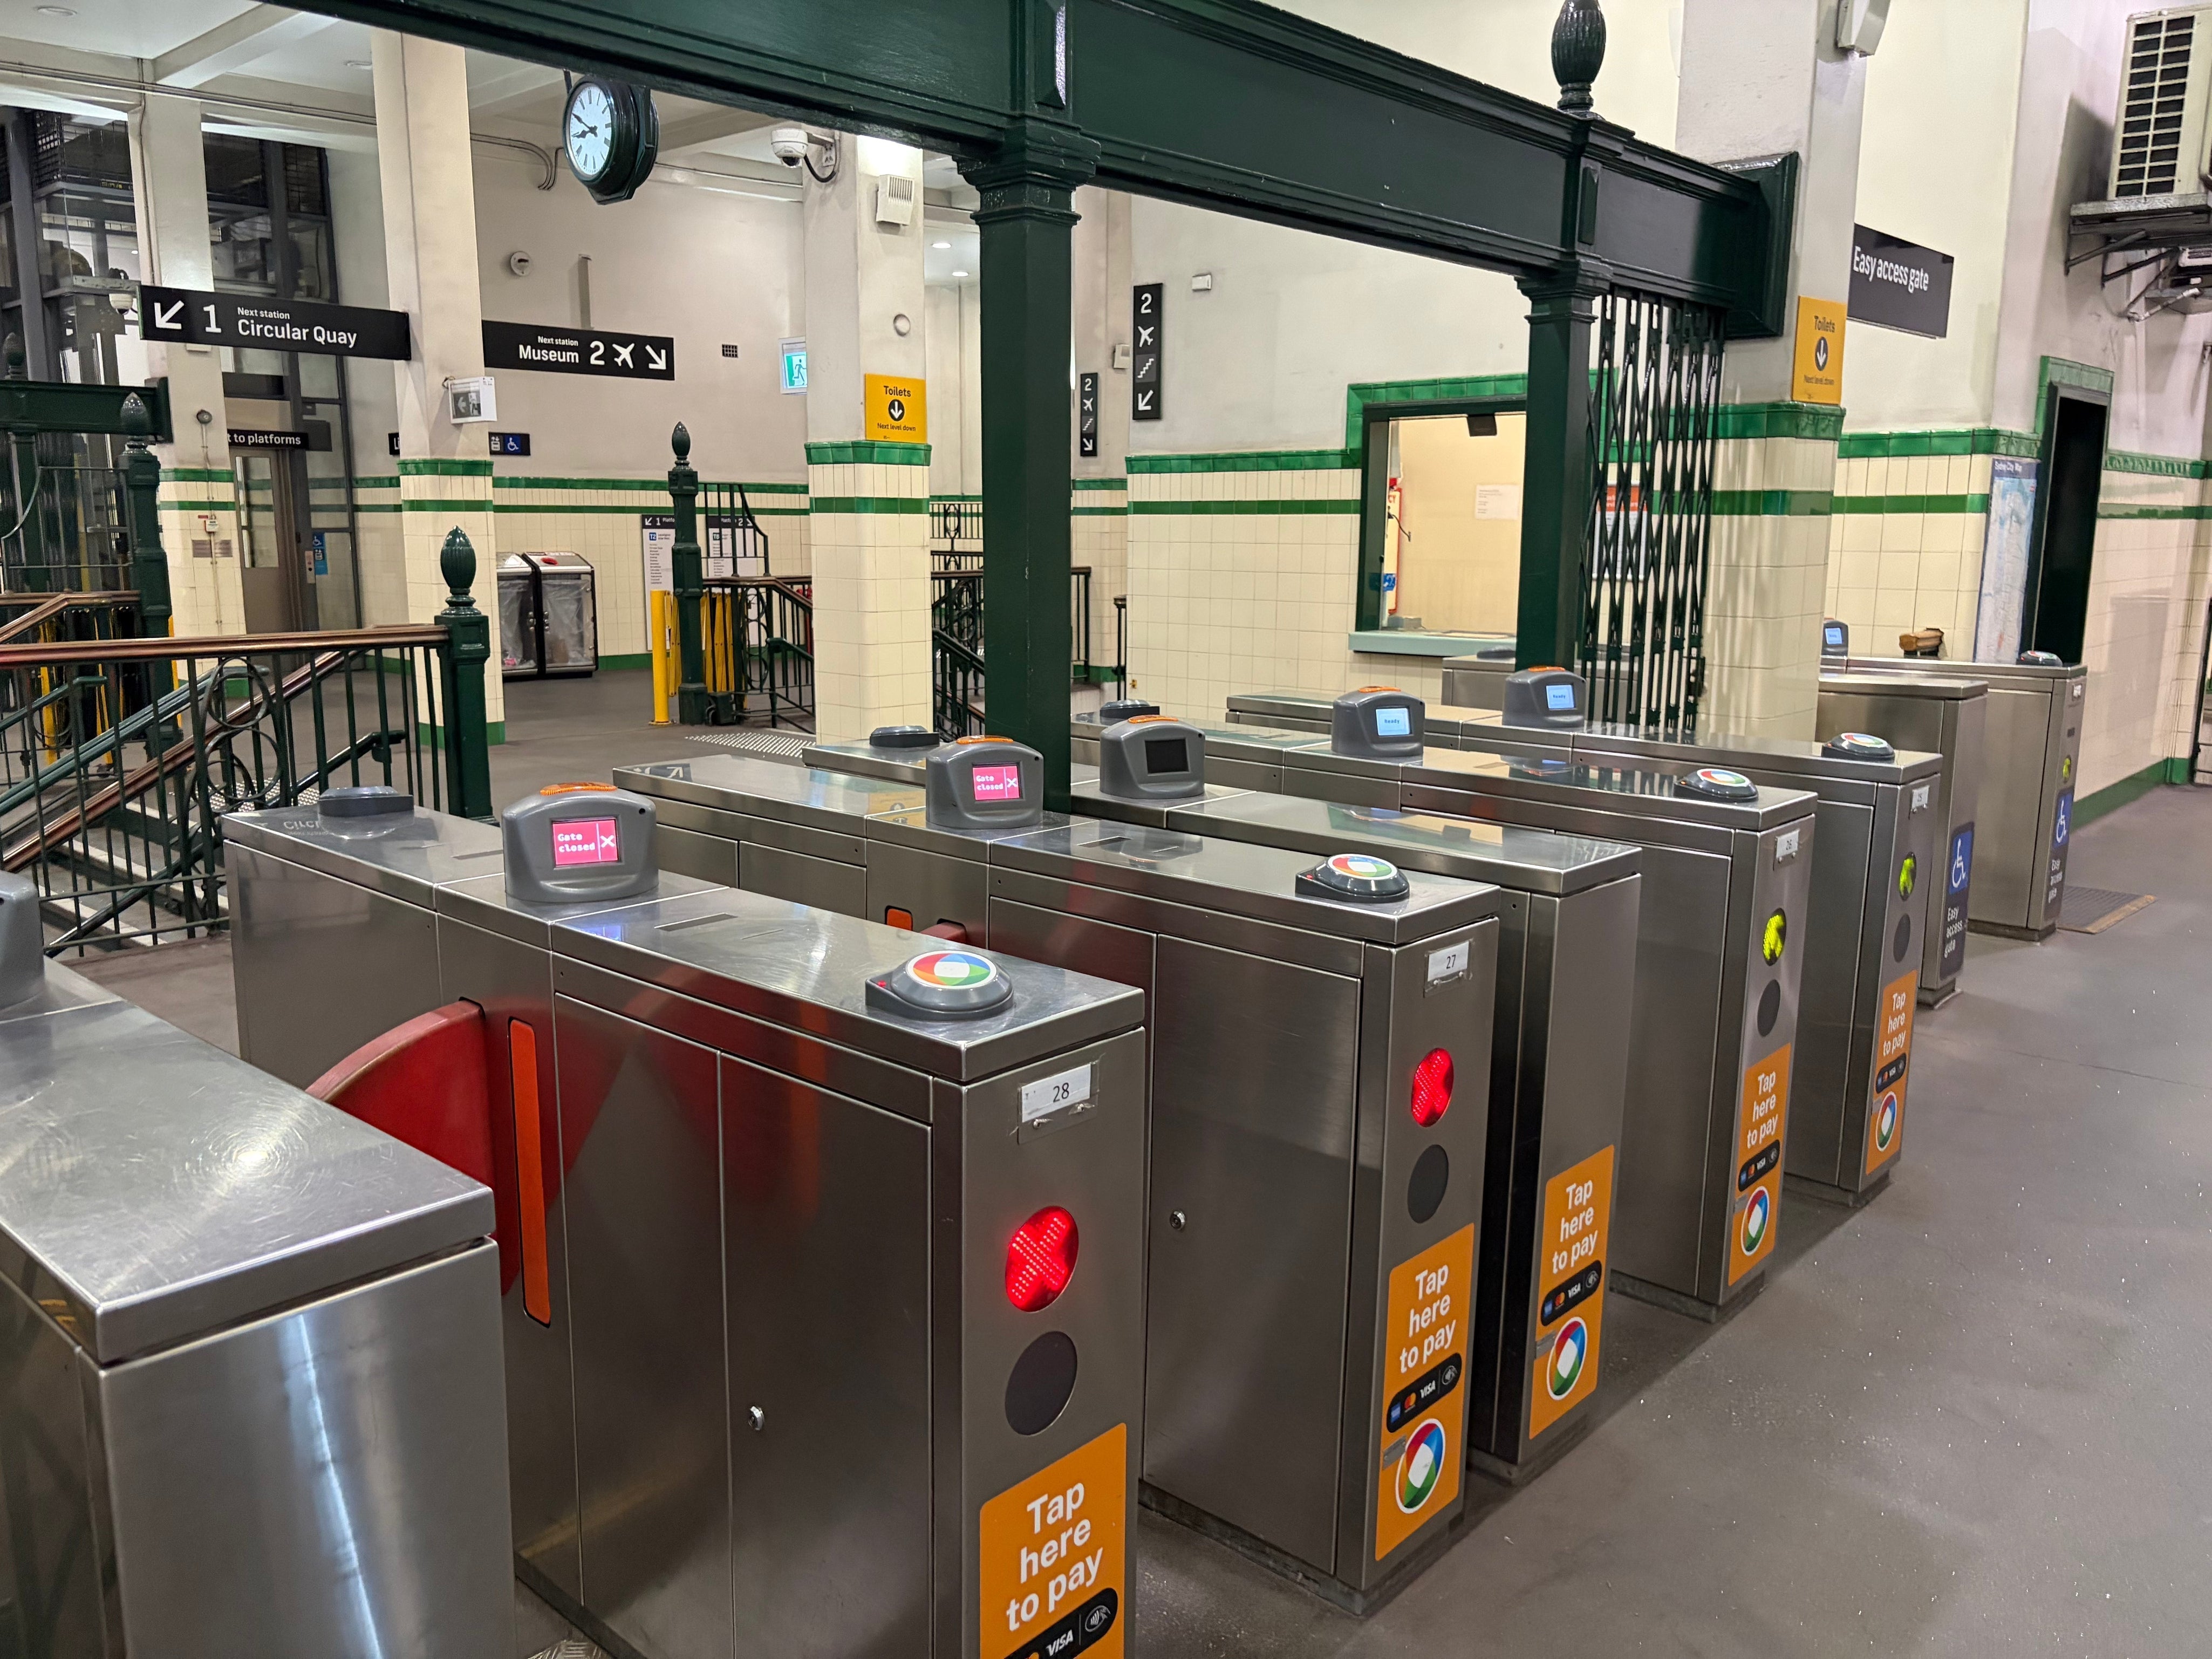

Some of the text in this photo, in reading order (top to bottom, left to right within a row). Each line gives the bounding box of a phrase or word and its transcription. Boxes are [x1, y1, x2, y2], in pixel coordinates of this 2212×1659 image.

[1853, 246, 1929, 293] Easy access gate
[237, 306, 290, 320] Next station
[1141, 293, 1152, 314] 2
[203, 304, 222, 333] 1
[1814, 316, 1835, 333] Toilets
[237, 319, 357, 349] Circular Quay
[538, 336, 578, 346] Next station
[519, 344, 579, 363] Museum
[590, 340, 605, 365] 2
[883, 385, 911, 397] Toilets
[1084, 378, 1092, 391] 2
[234, 433, 245, 443] to
[248, 433, 301, 445] platforms
[656, 517, 661, 525] 1
[977, 783, 1003, 791] closed
[557, 832, 583, 842] Gate
[559, 842, 595, 852] closed
[1786, 839, 1792, 850] 26
[1948, 906, 1959, 921] Easy
[1947, 920, 1962, 938] access
[1944, 939, 1956, 958] gate
[1446, 954, 1456, 970] 27
[1893, 992, 1906, 1012] Tap
[1888, 1011, 1906, 1034] here
[1883, 1030, 1907, 1057] to pay
[1053, 1082, 1069, 1102] 28
[1758, 1071, 1776, 1095] Tap
[1752, 1094, 1776, 1122] here
[1747, 1115, 1778, 1149] to pay
[1566, 1179, 1593, 1210] Tap
[1560, 1207, 1594, 1242] here
[1552, 1230, 1598, 1274] to pay
[1415, 1265, 1449, 1300] Tap
[1568, 1282, 1581, 1299] VISA
[1409, 1294, 1451, 1337] here
[1399, 1320, 1456, 1373] to pay
[1420, 1380, 1435, 1398] VISA
[1027, 1483, 1084, 1534] Tap
[1020, 1519, 1091, 1583] here
[1006, 1547, 1103, 1632] to pay
[1046, 1629, 1074, 1656] VISA
